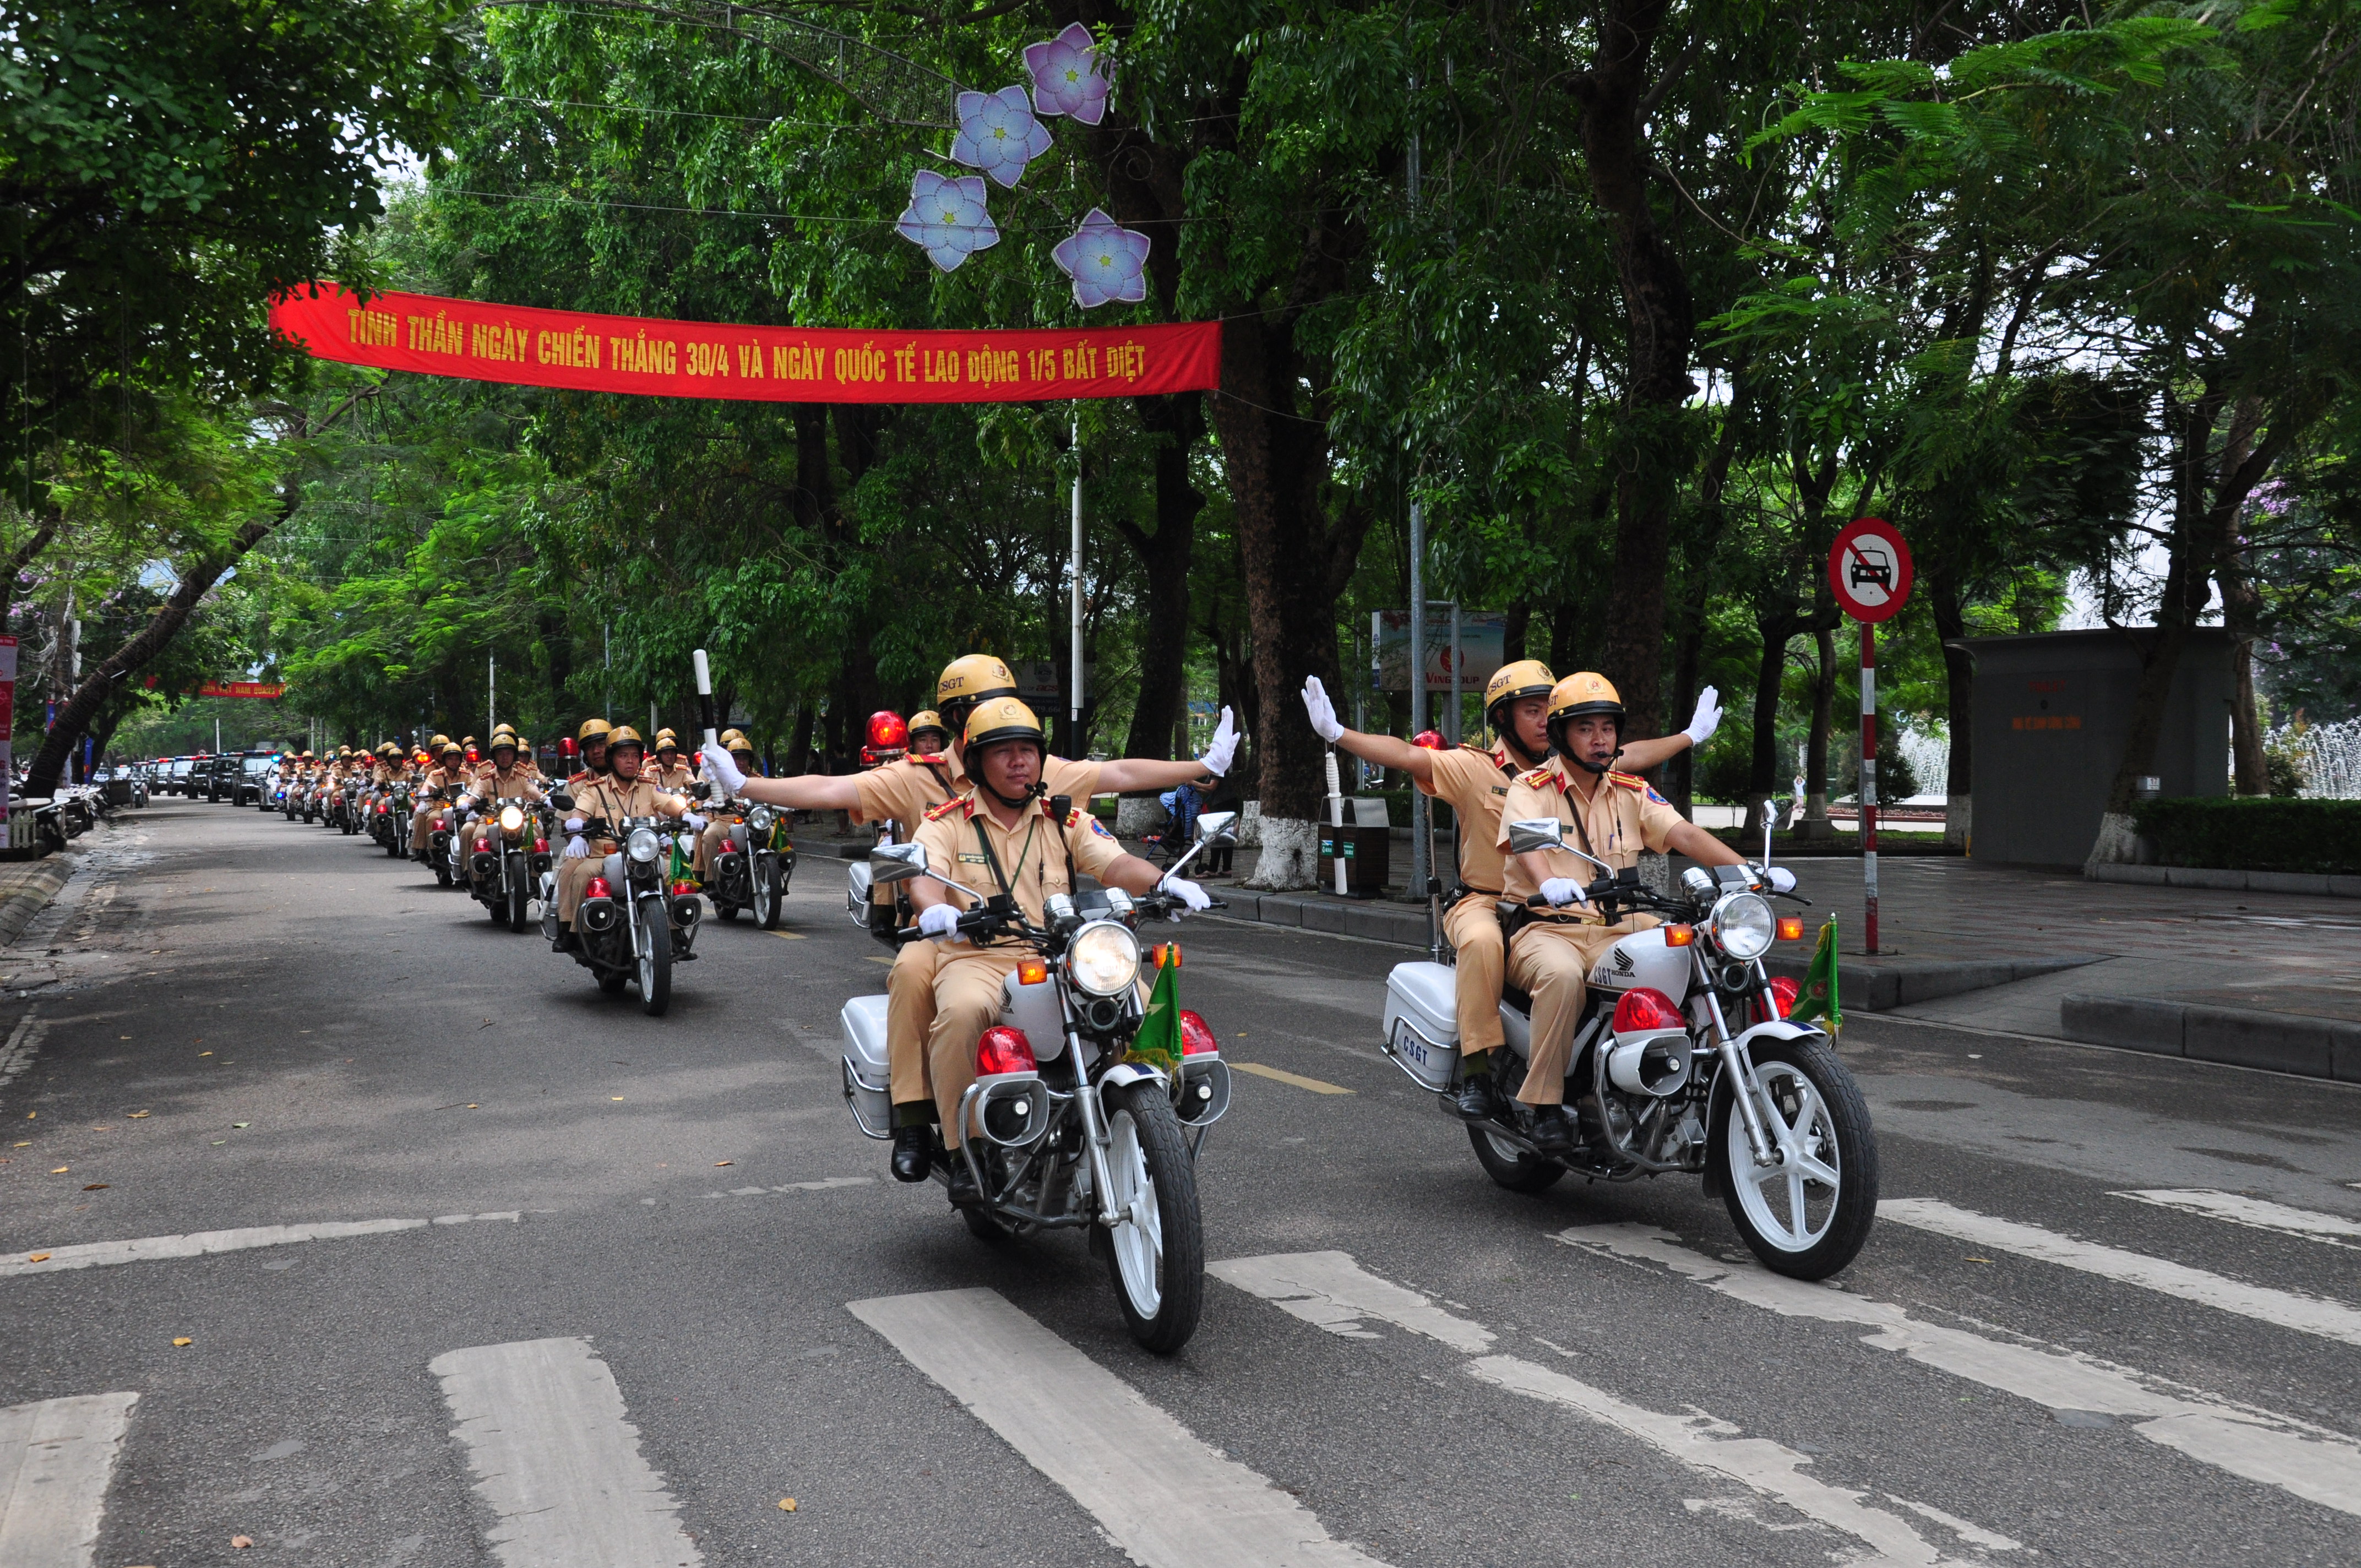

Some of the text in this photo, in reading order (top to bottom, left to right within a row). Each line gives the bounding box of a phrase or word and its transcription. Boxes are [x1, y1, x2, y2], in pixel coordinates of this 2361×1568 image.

[347, 308, 1145, 389] TINH THẦN NGÀY CHIẾN THẮNG 30/4 VÀ NGÀY QUỐC TẾ LAO ĐỘNG 1/5 BẤT DIỆT
[938, 676, 964, 693] CSGT
[1426, 672, 1479, 684] VINGOUP
[1488, 674, 1511, 695] CSGT
[1594, 965, 1612, 986] CSGT
[1611, 969, 1636, 978] HONDA
[1403, 1036, 1428, 1066] CSGT
